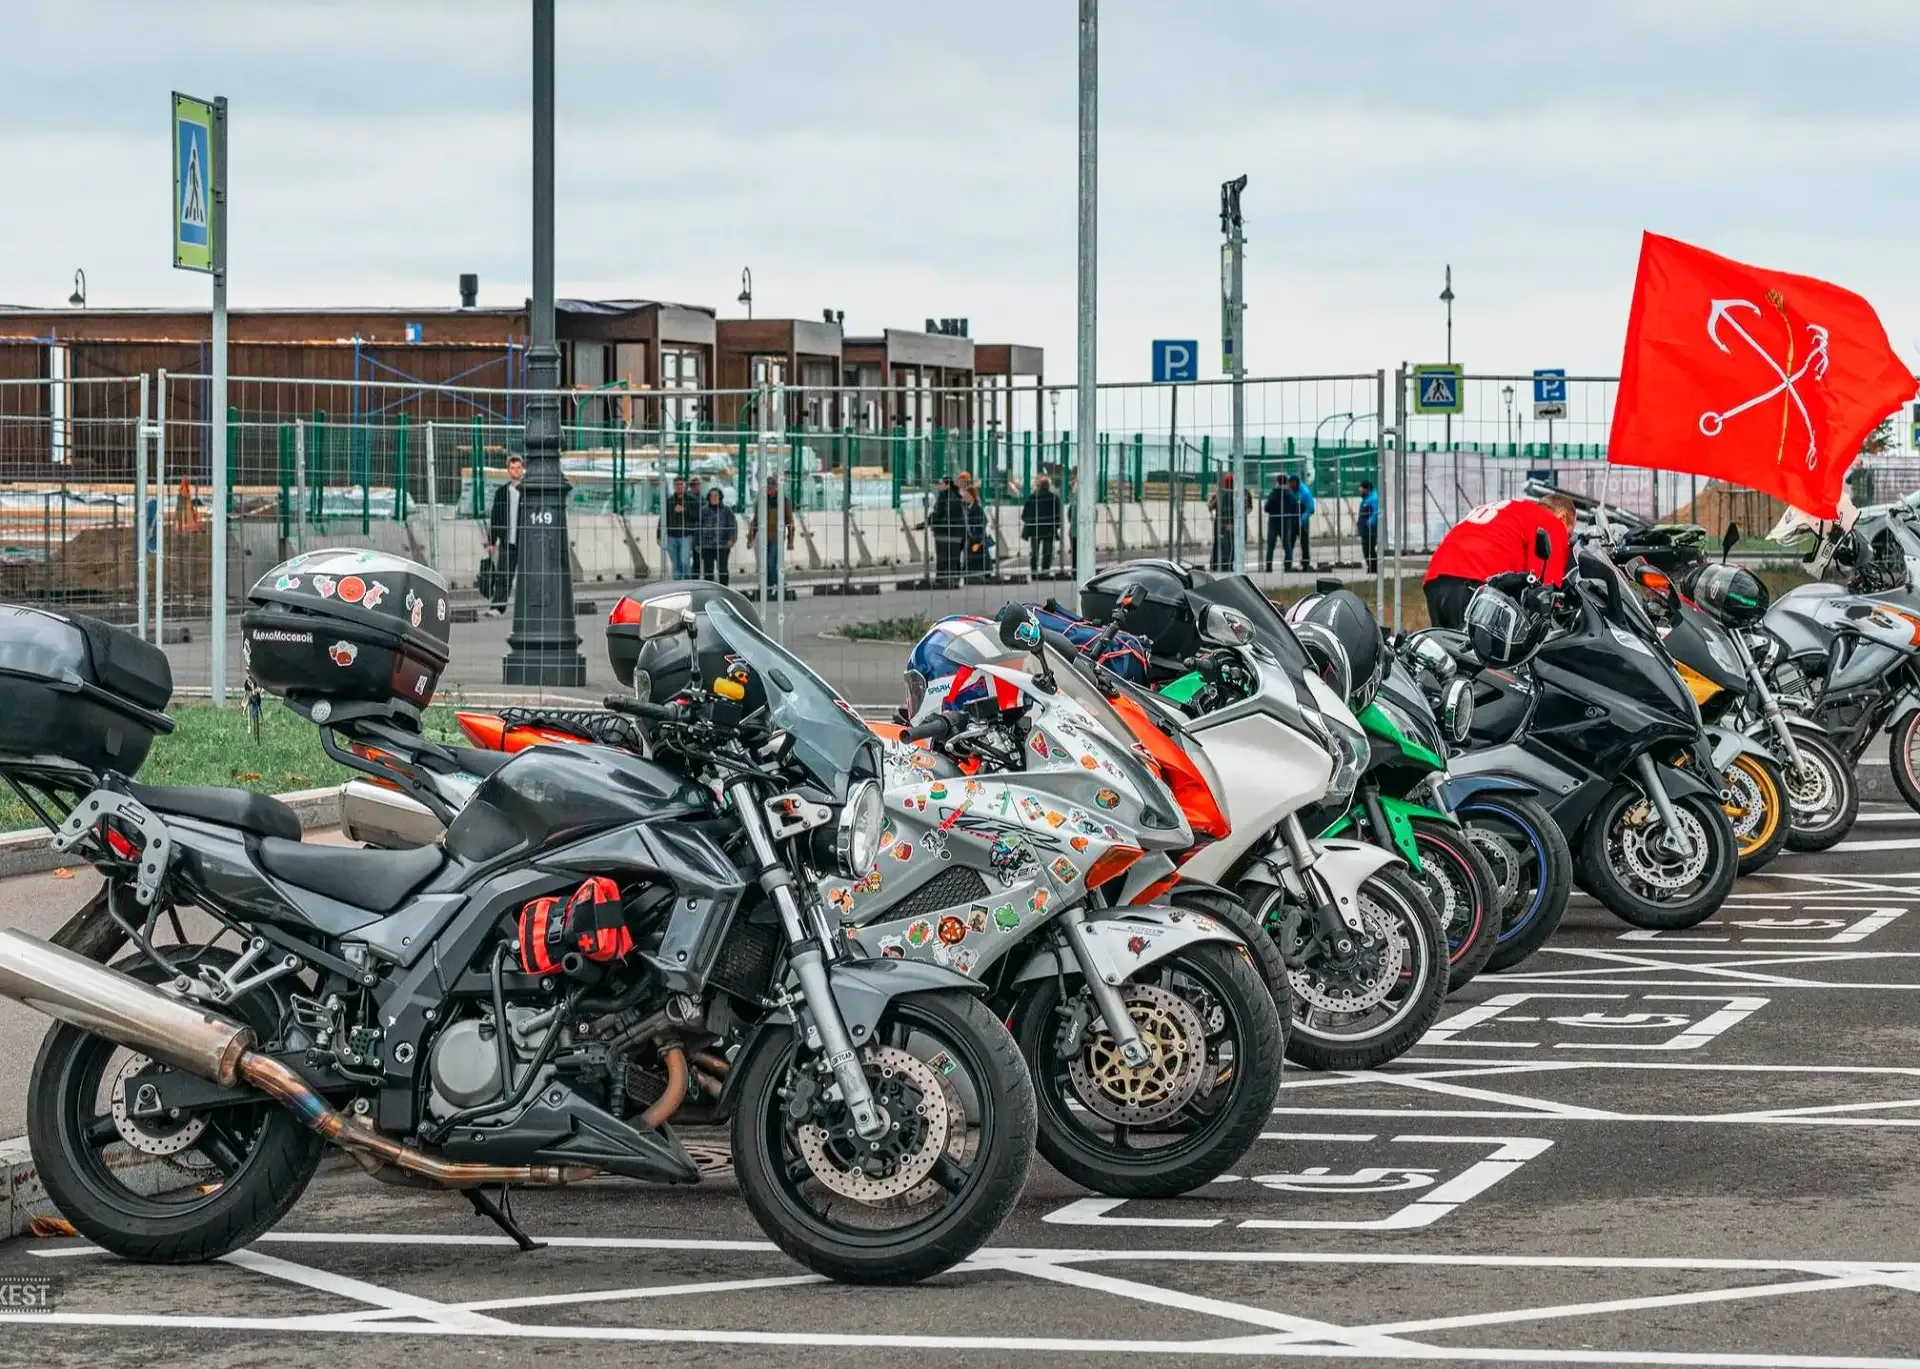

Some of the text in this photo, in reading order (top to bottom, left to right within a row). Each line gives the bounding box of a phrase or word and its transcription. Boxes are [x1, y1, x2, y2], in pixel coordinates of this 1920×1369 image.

[1165, 345, 1189, 380] P
[1542, 373, 1560, 399] P
[530, 511, 552, 524] 149
